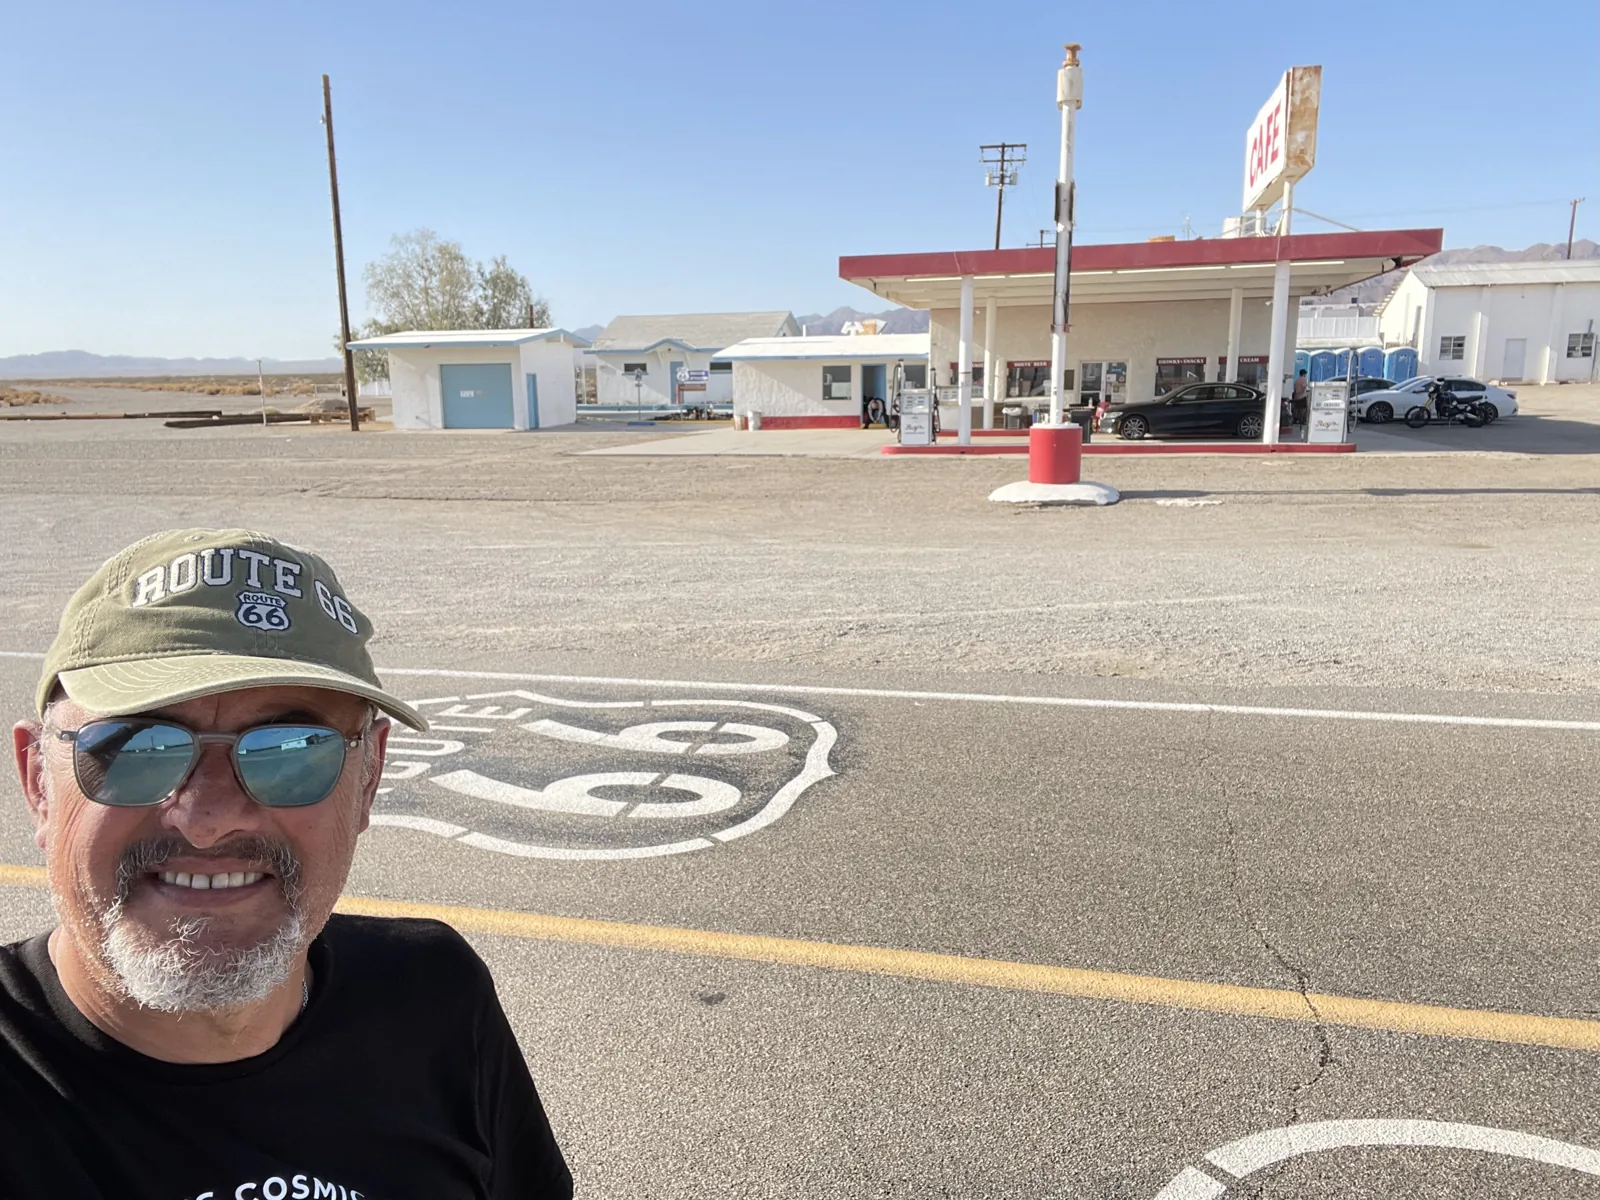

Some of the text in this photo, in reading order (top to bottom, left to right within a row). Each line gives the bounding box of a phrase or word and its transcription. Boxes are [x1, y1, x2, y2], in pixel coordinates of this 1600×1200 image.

[1250, 99, 1281, 188] CAFE
[132, 548, 359, 634] ROUTE 66
[242, 604, 285, 627] 66
[243, 593, 283, 607] ROUTE
[429, 719, 790, 819] 66
